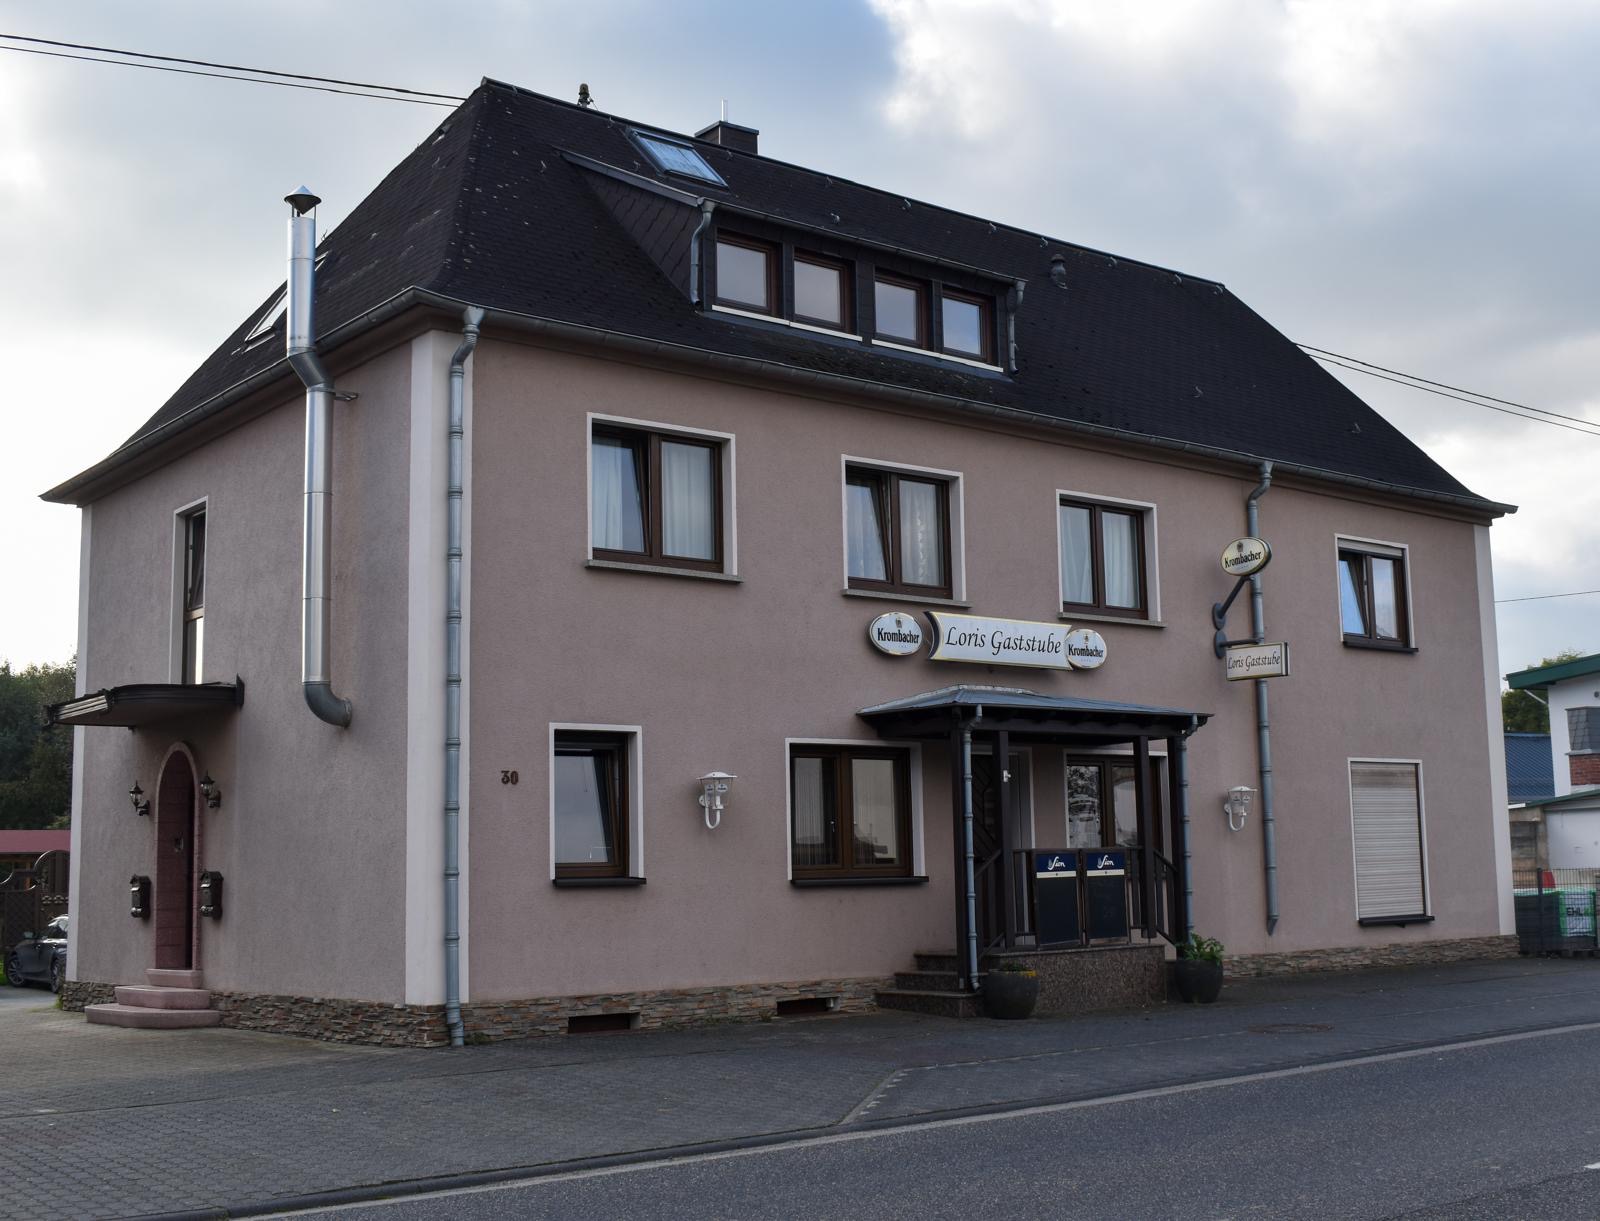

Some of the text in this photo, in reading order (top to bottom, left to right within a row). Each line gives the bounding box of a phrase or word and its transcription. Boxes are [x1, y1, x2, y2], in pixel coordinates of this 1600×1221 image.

[1225, 550, 1261, 568] Krombacher
[877, 628, 919, 644] Krombacher
[945, 626, 1061, 656] Loris Gaststube
[1068, 643, 1104, 658] Krombacher
[1228, 650, 1280, 671] Loris Gaststube
[501, 770, 519, 785] 30
